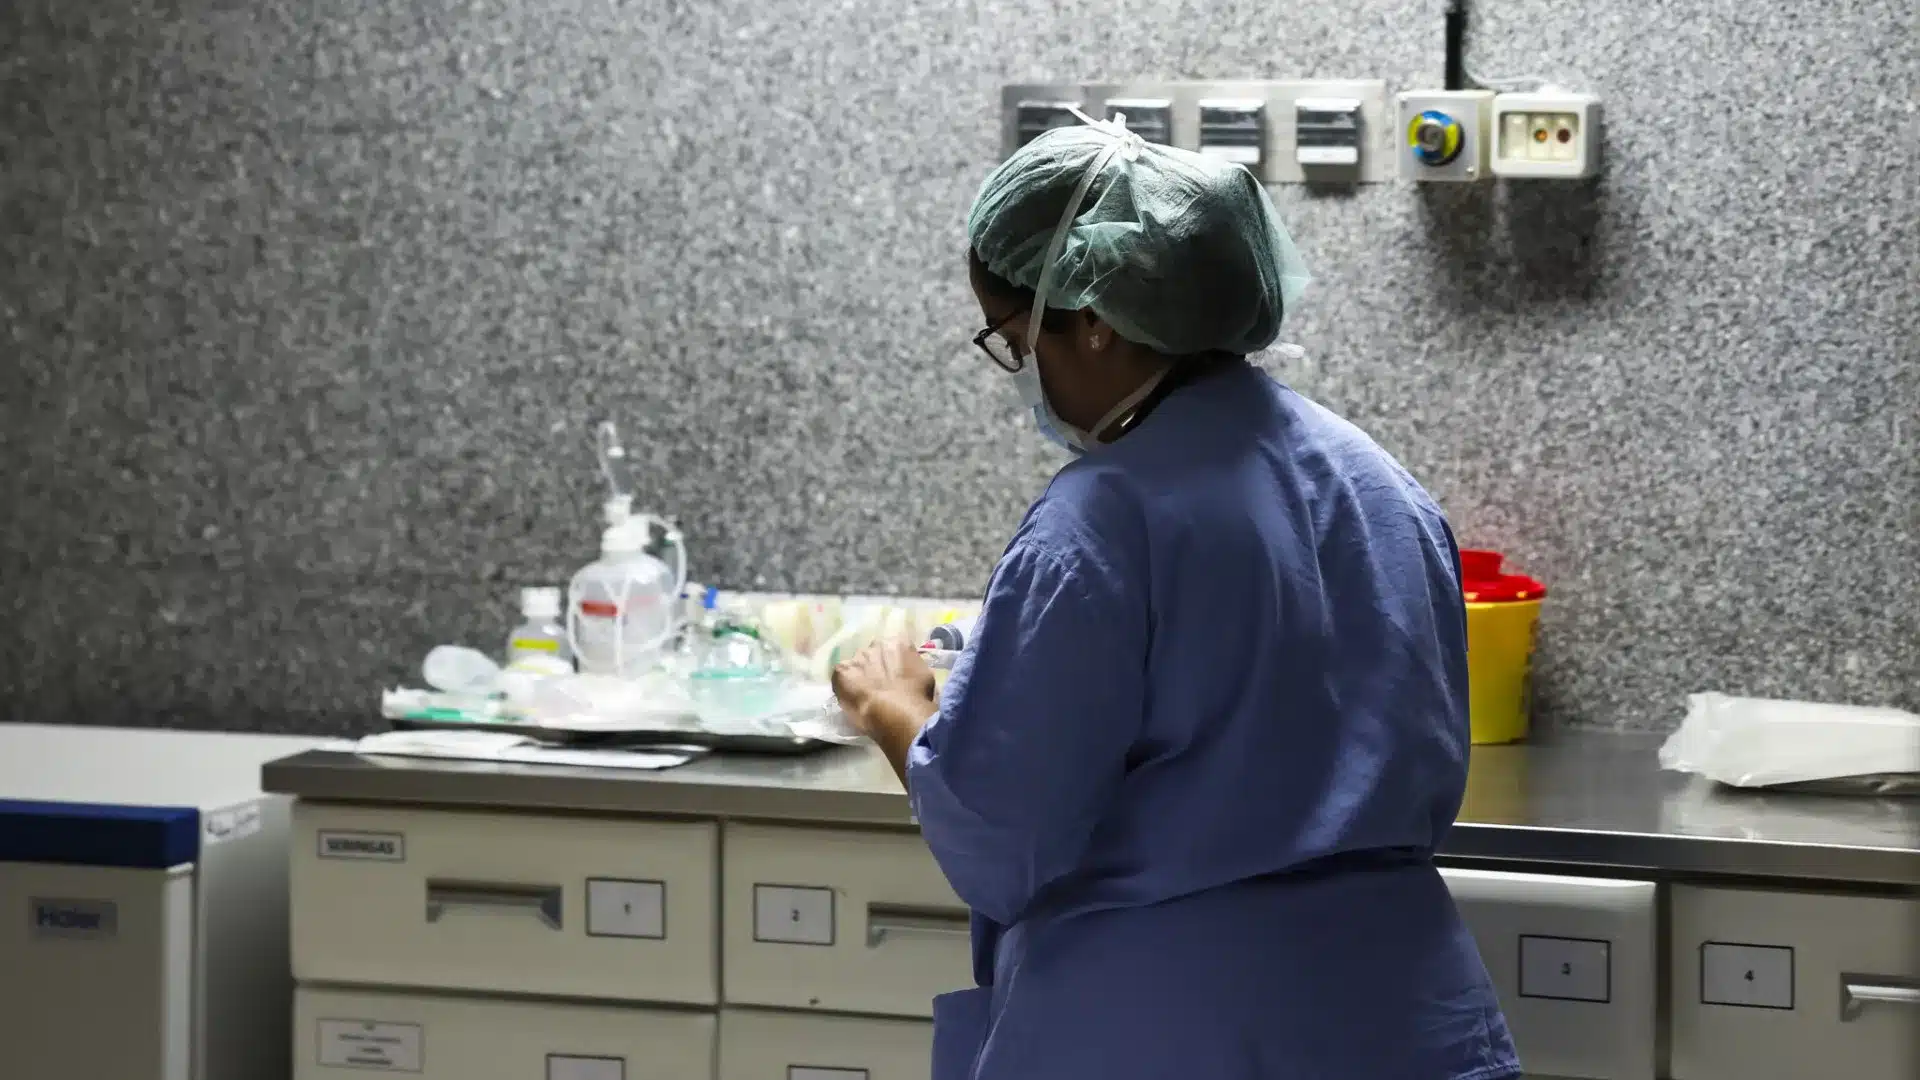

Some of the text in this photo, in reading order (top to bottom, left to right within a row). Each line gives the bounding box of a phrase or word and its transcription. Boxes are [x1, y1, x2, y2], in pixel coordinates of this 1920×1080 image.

[791, 909, 800, 922] 2
[1561, 962, 1572, 976] 3
[1744, 969, 1755, 982] 4
